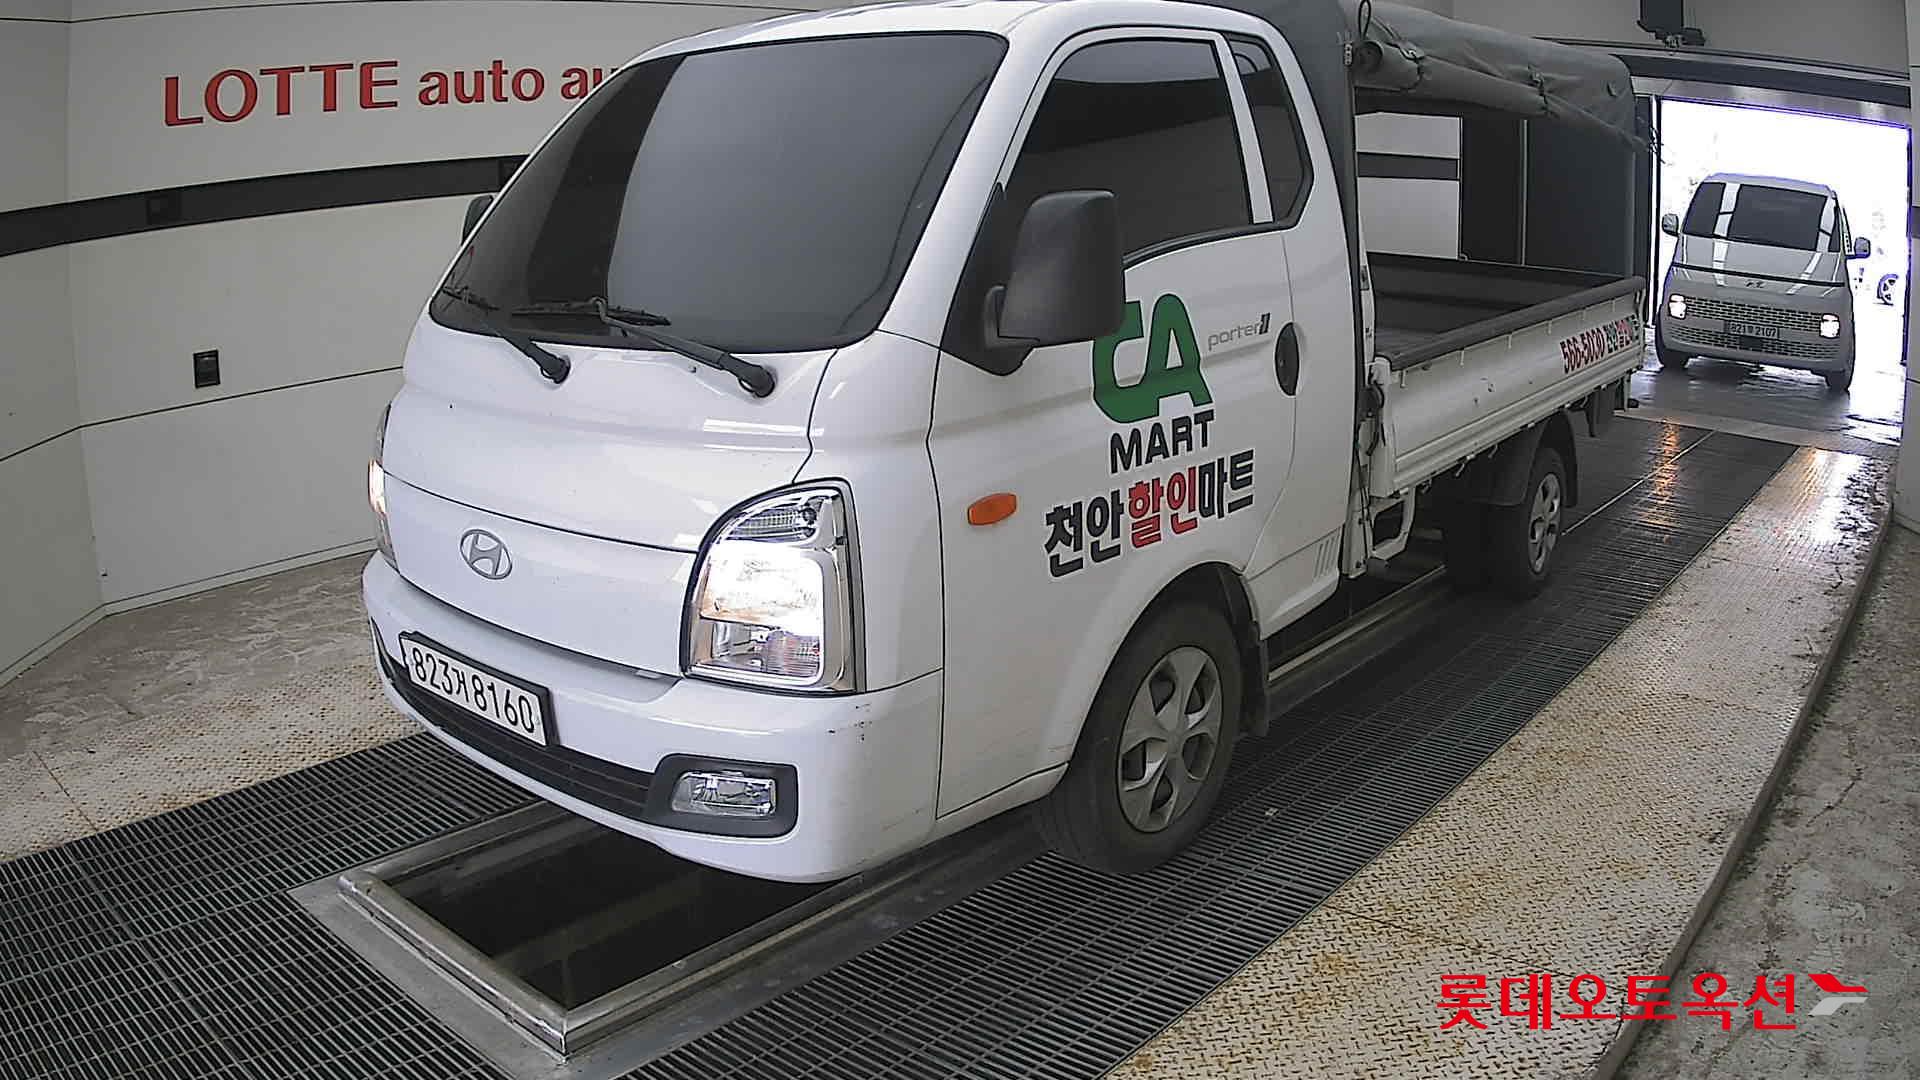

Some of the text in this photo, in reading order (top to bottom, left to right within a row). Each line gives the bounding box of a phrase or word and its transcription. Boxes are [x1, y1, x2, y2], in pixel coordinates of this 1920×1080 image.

[163, 60, 398, 127] LOTTE
[418, 60, 545, 106] auto
[1110, 409, 1215, 474] MART
[1045, 449, 1254, 578] 천안할인마트
